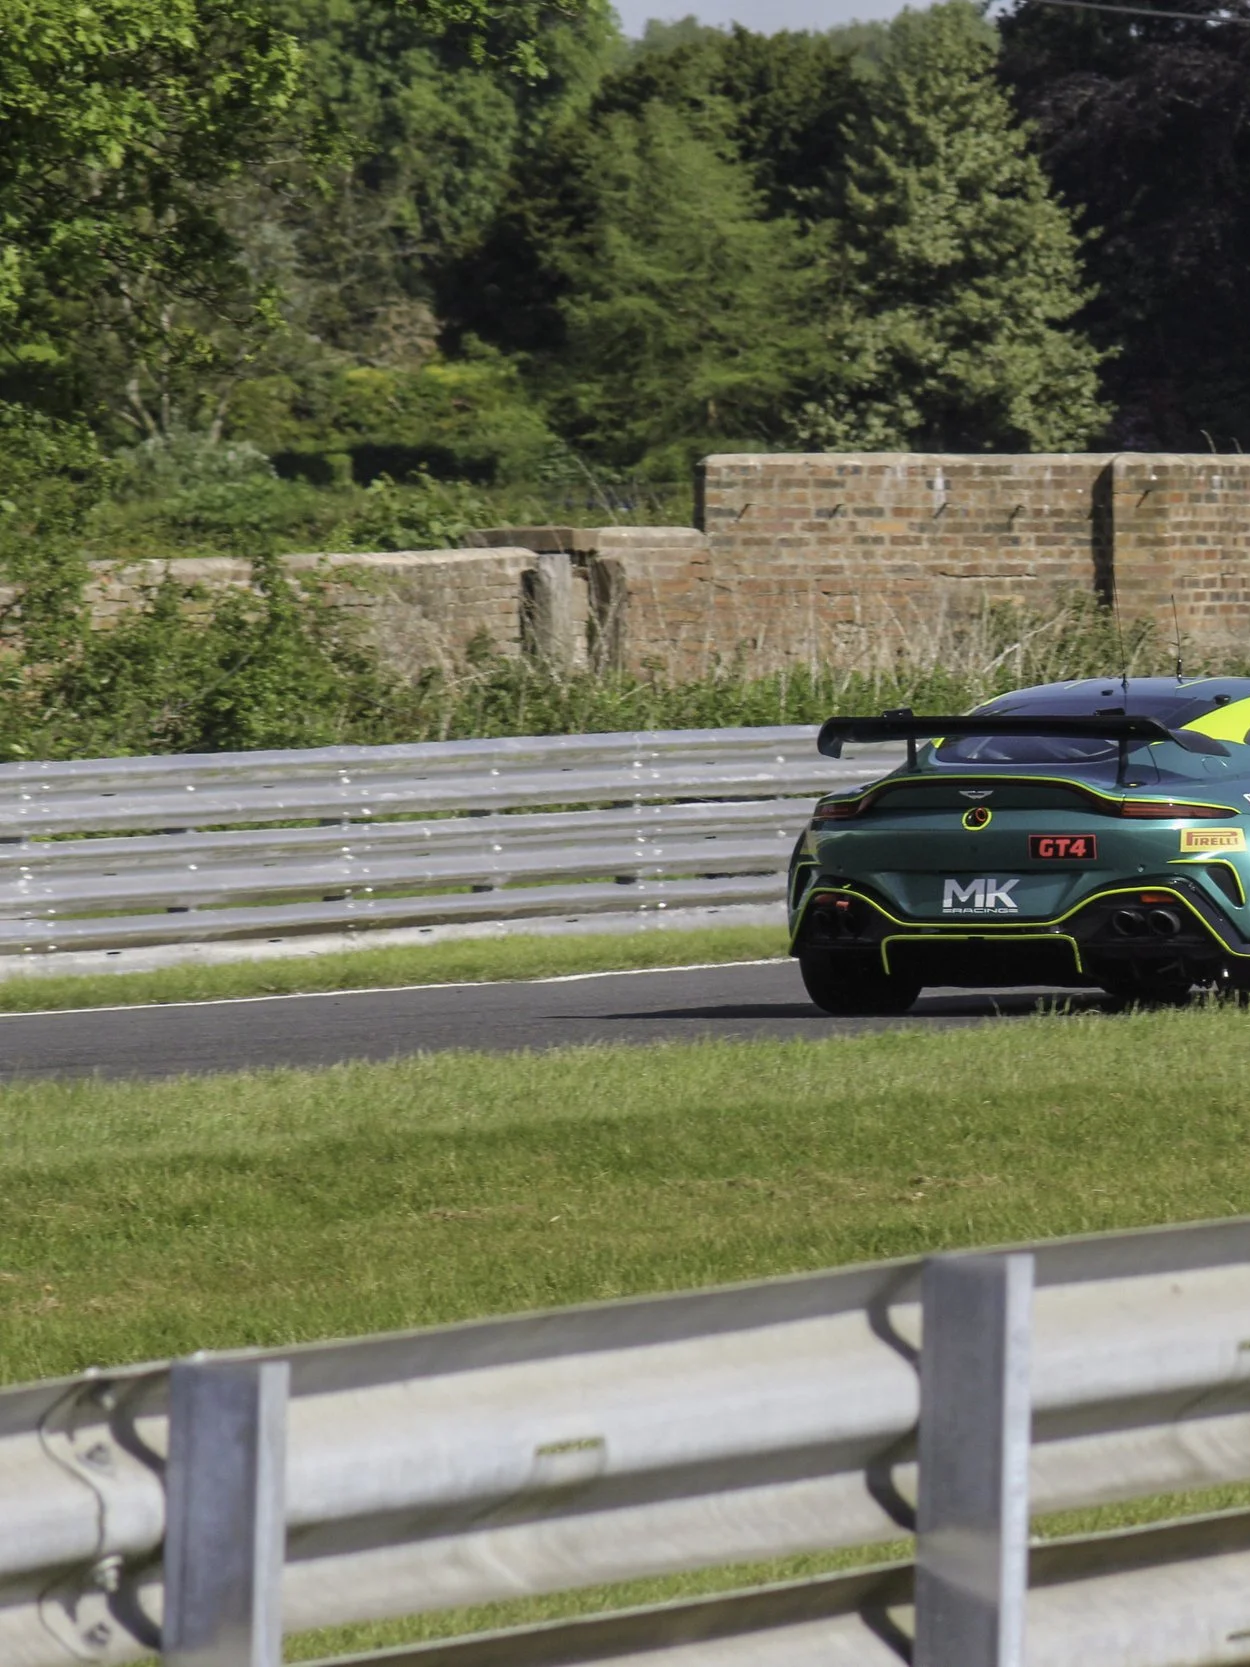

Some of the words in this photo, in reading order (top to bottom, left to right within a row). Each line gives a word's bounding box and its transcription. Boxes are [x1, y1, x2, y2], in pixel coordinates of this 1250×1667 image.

[1186, 831, 1239, 846] PIRELLI
[1039, 839, 1087, 857] GT4
[942, 878, 1020, 908] MK
